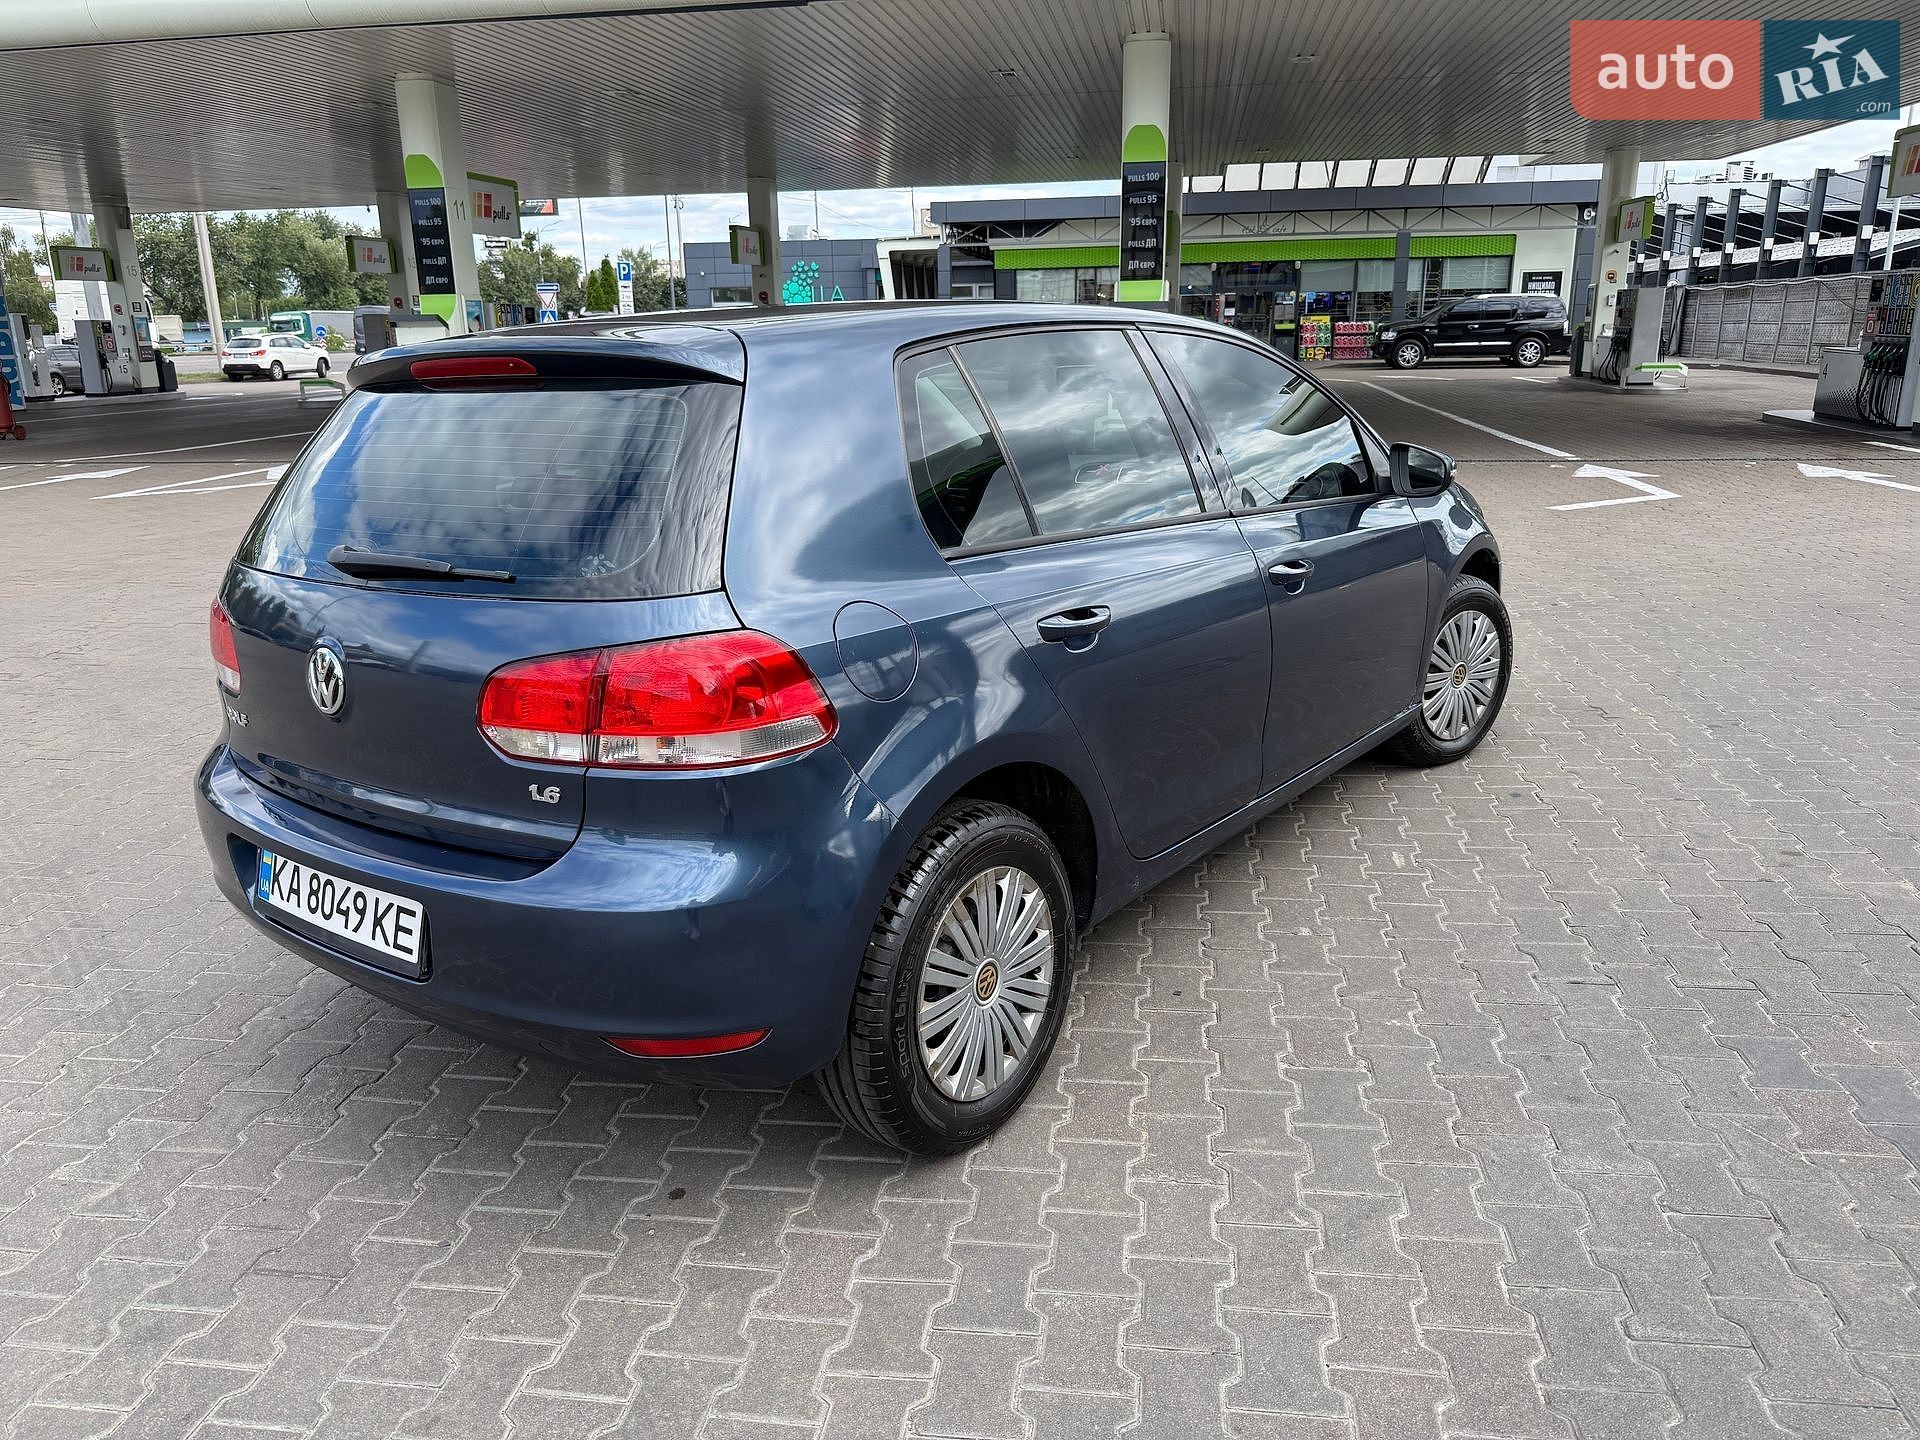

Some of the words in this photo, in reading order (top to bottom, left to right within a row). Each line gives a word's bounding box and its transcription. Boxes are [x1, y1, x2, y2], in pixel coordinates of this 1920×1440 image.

[1127, 174, 1145, 182] PULLS
[1145, 172, 1160, 181] 100
[429, 197, 441, 206] 100
[1129, 196, 1147, 204] PULLS
[1147, 194, 1158, 204] 95
[453, 199, 466, 221] 11
[492, 205, 512, 223] pulls
[433, 217, 442, 226] 95
[1127, 240, 1145, 248] PULLS
[1145, 238, 1157, 248] ДП
[84, 262, 102, 275] pulls
[126, 265, 138, 277] 15
[1128, 260, 1139, 270] ДП
[620, 263, 629, 280] P
[118, 364, 129, 375] 15
[1822, 363, 1829, 379] 4
[260, 877, 270, 893] UA
[271, 854, 301, 908] KA
[307, 872, 368, 934] 8049
[371, 896, 417, 956] KE
